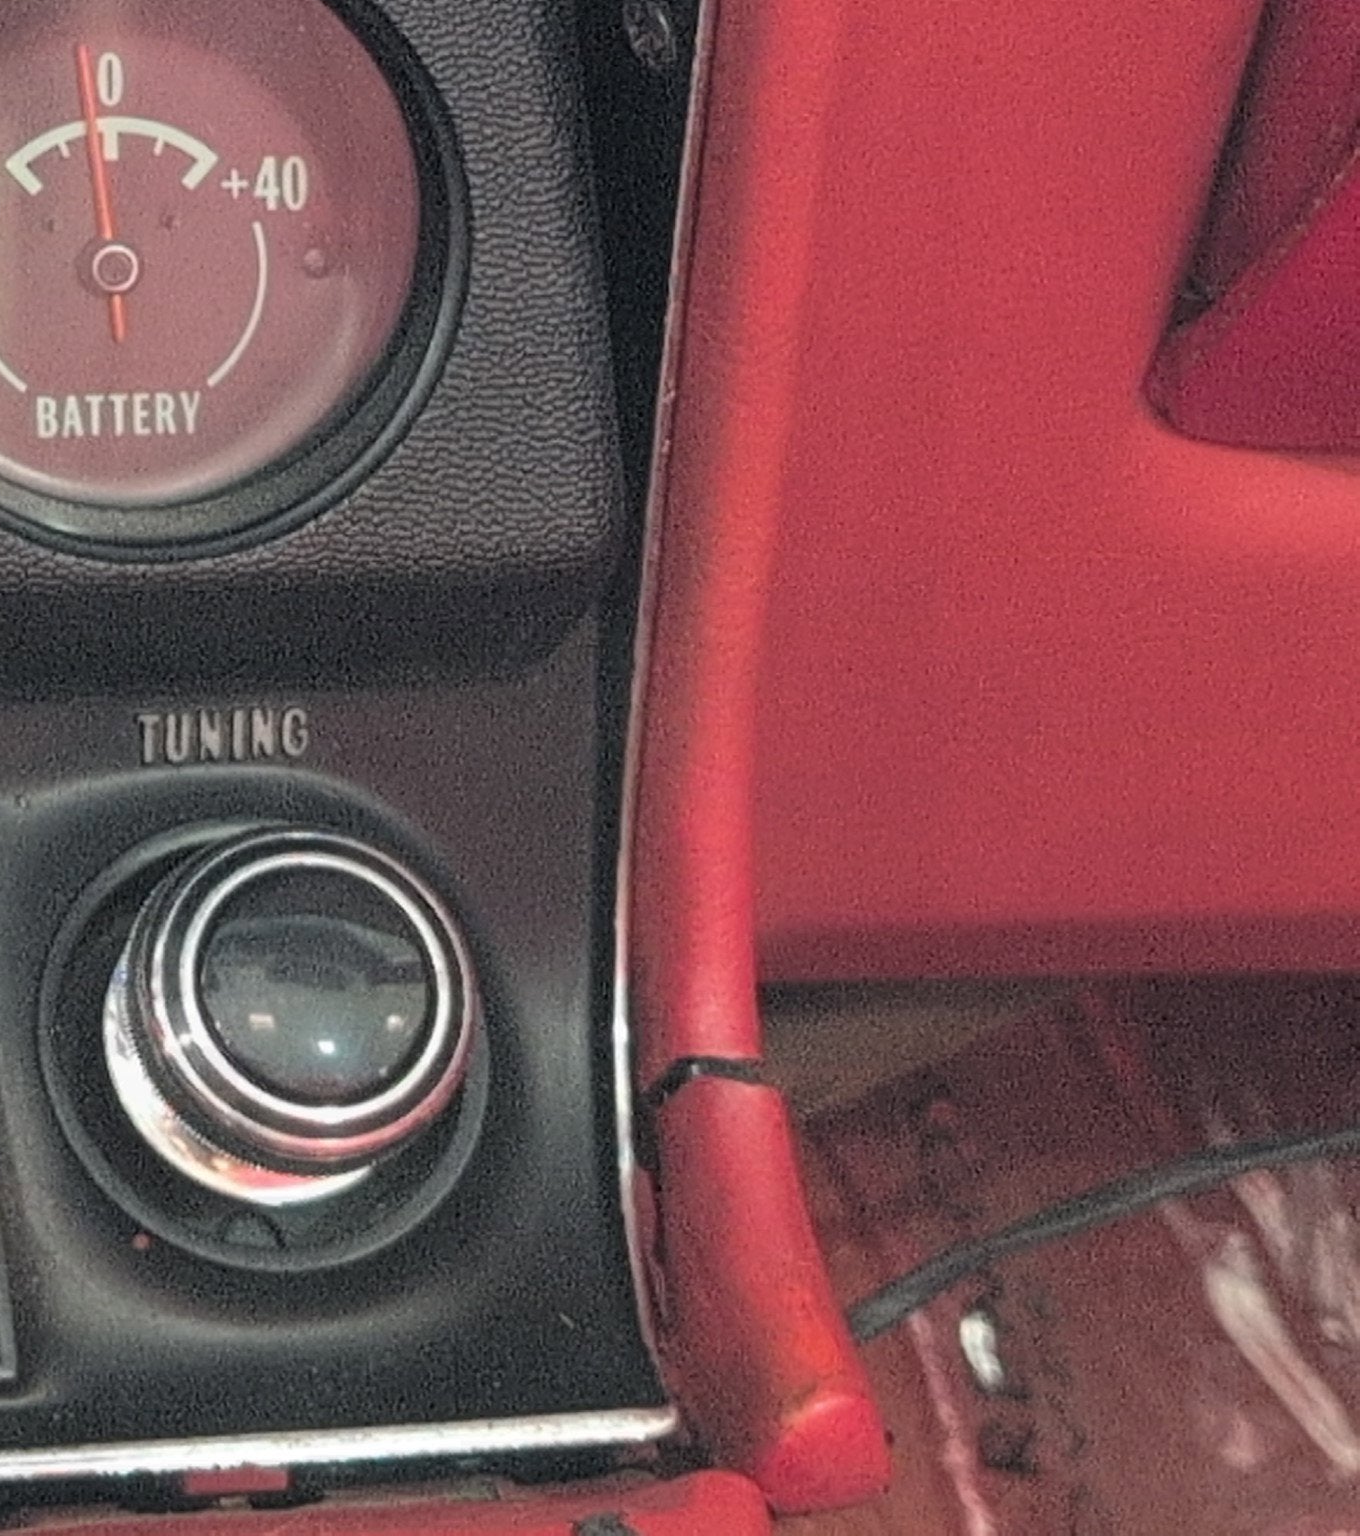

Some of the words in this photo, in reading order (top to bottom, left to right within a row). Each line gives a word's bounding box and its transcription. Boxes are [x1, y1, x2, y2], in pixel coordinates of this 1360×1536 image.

[97, 52, 124, 106] 0
[221, 156, 308, 211] +40
[36, 391, 201, 439] BATTERY
[138, 707, 310, 763] TUNING
